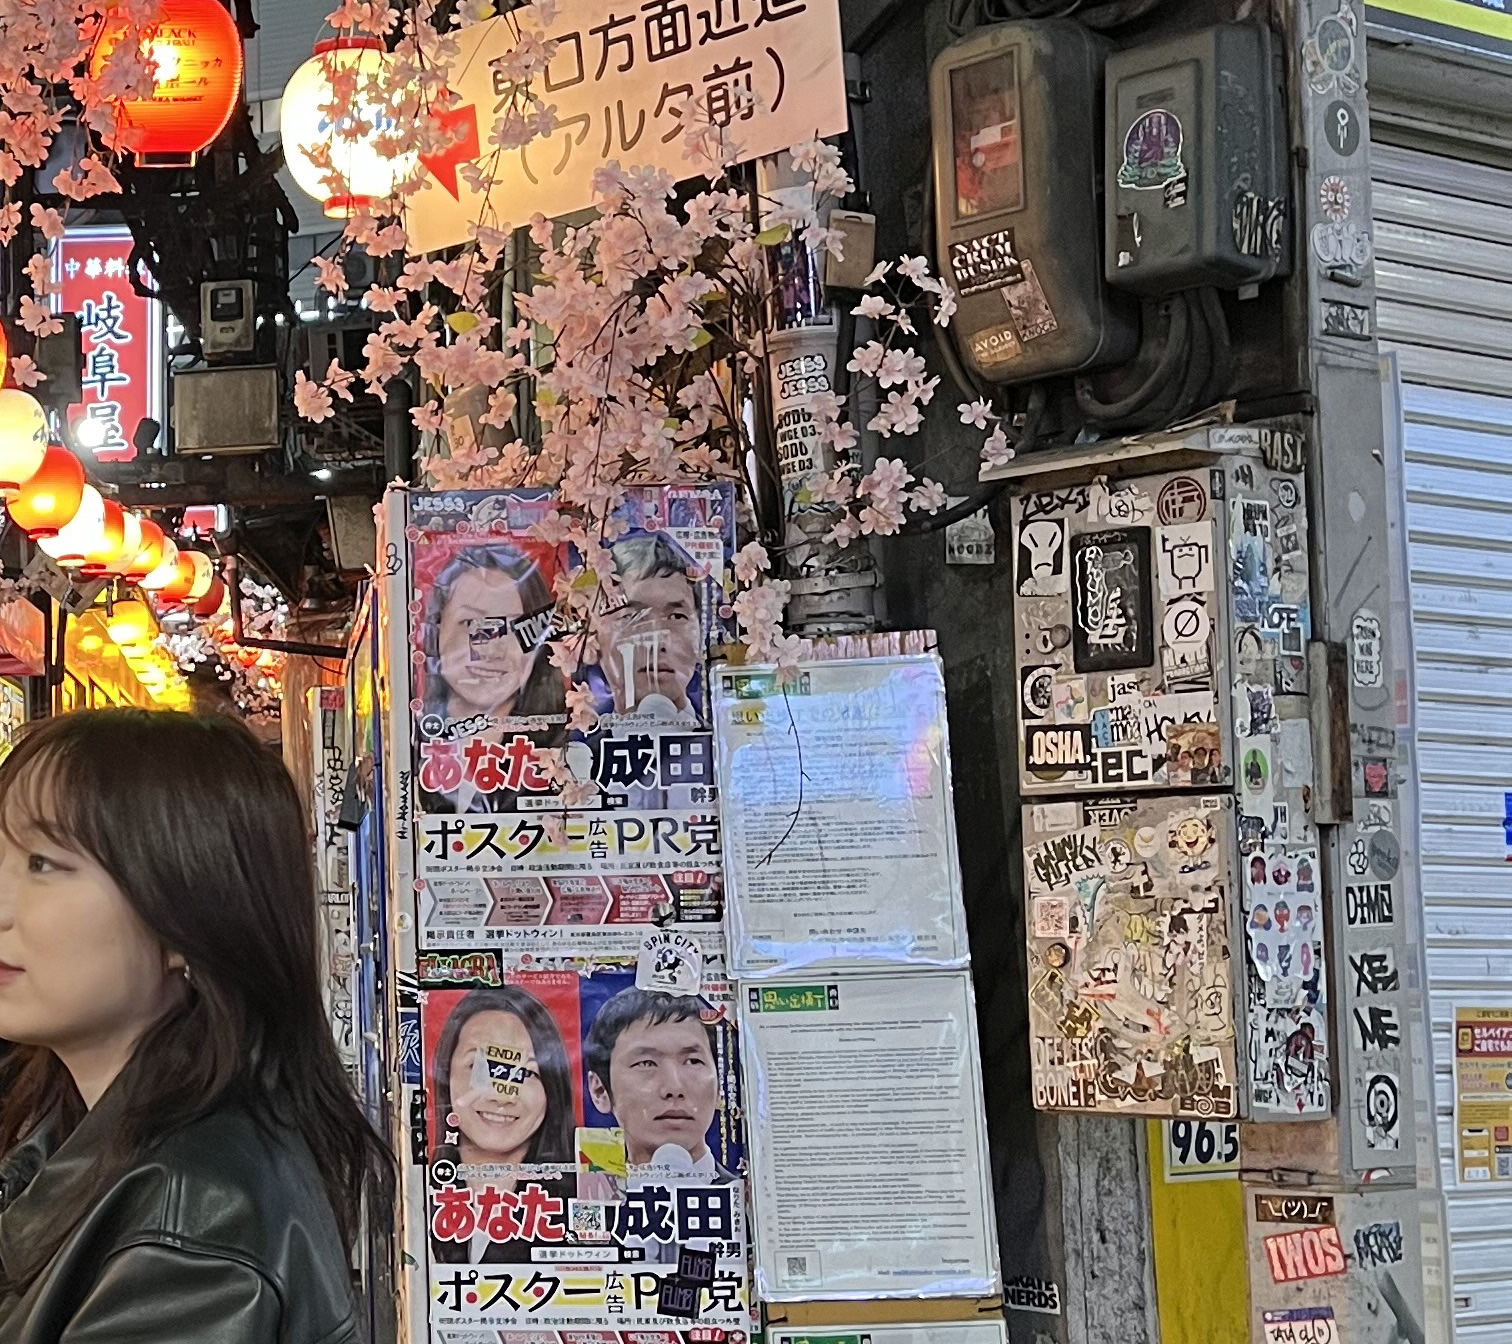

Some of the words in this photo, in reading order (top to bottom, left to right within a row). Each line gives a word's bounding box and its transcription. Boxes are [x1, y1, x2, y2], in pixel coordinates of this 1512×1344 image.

[973, 329, 1013, 354] AVOID
[76, 292, 133, 452] 岐阜屋
[780, 375, 831, 400] JESS3
[419, 734, 550, 794] あなた
[597, 733, 714, 792] 成田
[1030, 730, 1087, 765] OSHA
[424, 819, 585, 860] ポスター
[614, 814, 721, 857] PR党
[1171, 1120, 1239, 1164] 96.5
[432, 1185, 564, 1243] あなた
[611, 1184, 732, 1244] 成田
[437, 1270, 602, 1314] ポスター
[604, 1270, 626, 1315] 広告
[1004, 1287, 1058, 1309] NERDS
